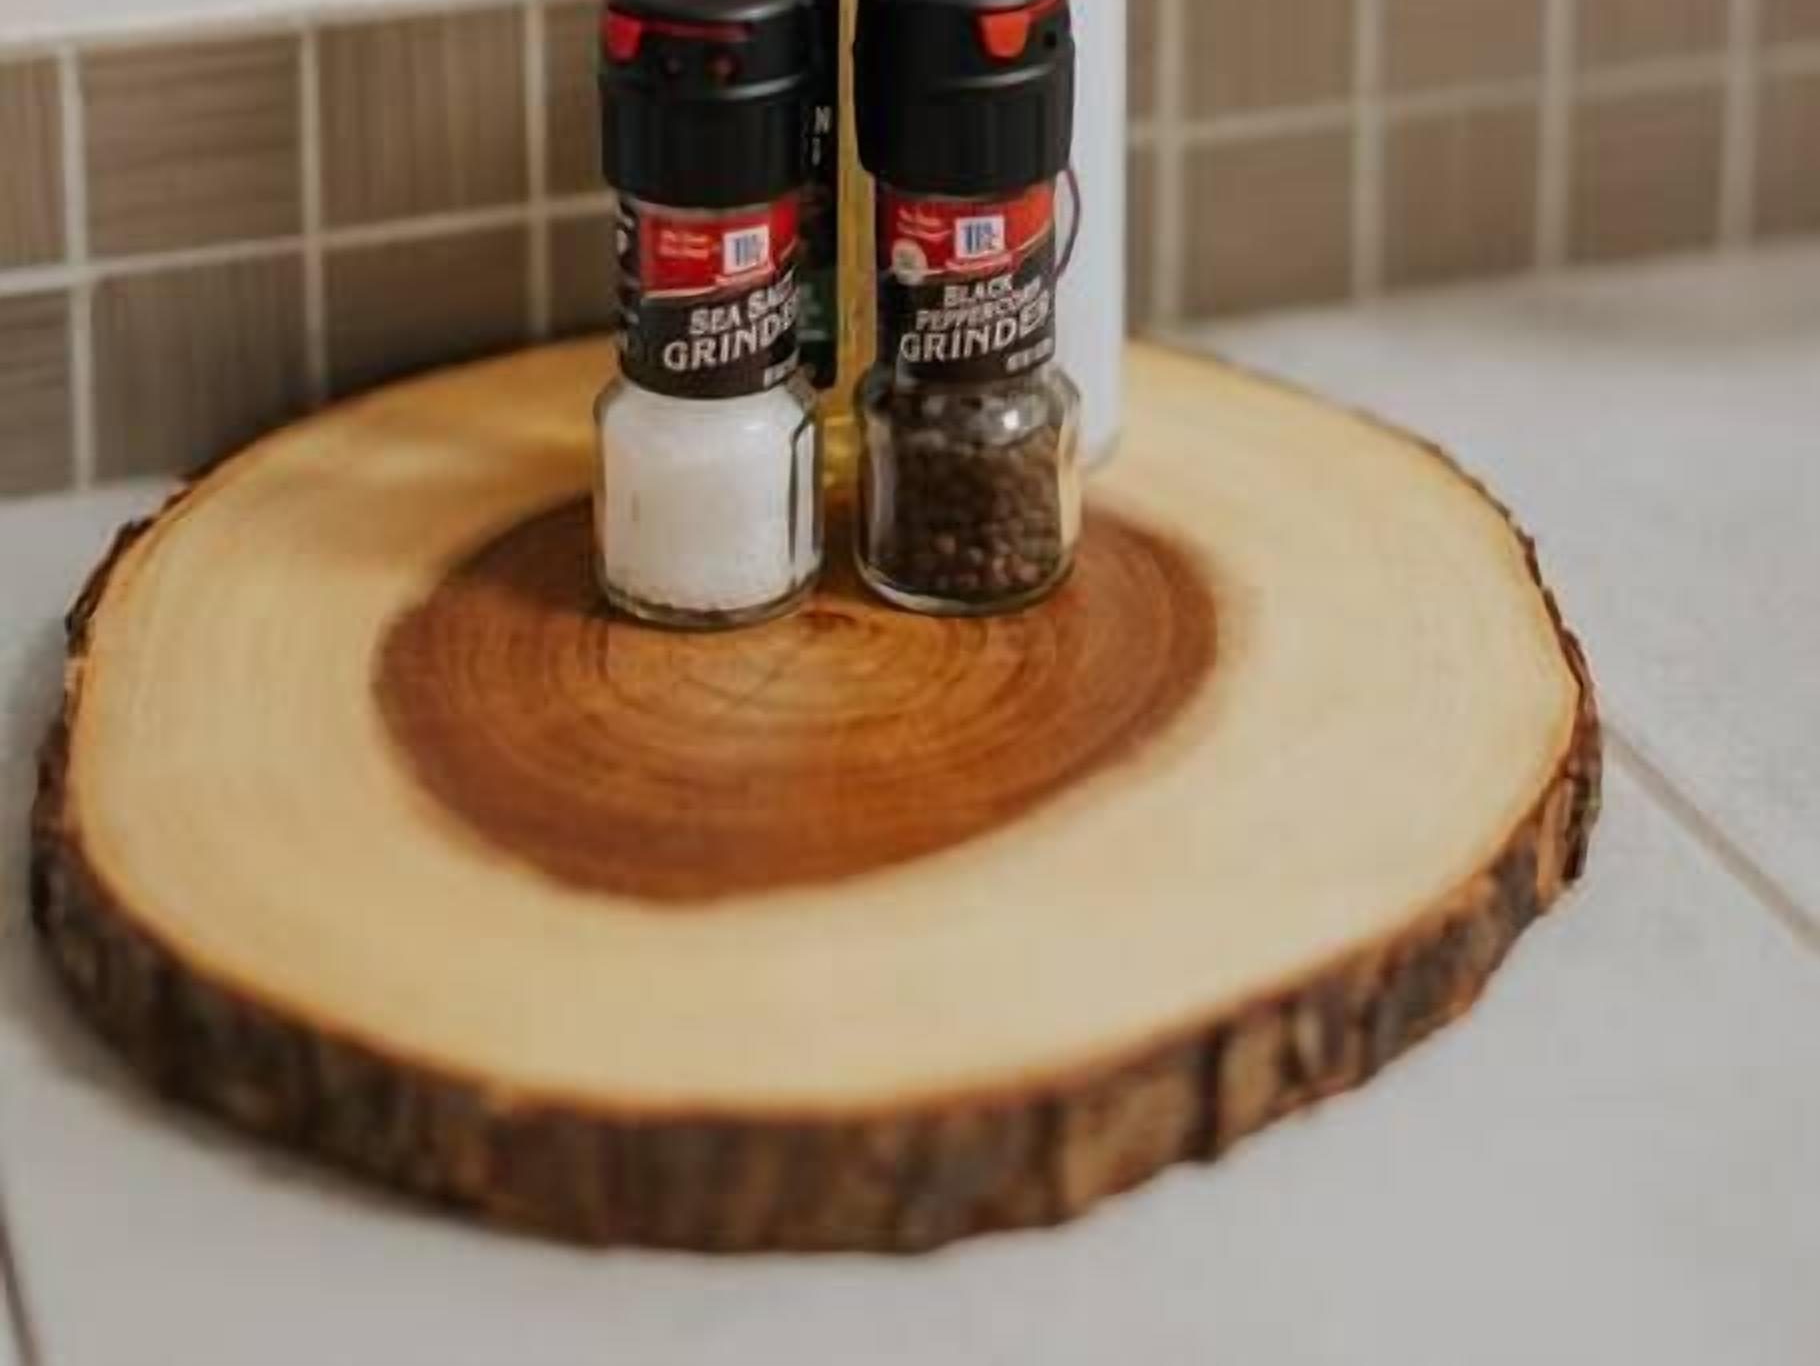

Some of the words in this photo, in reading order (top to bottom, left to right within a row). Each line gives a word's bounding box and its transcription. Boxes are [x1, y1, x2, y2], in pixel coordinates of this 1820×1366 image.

[943, 274, 1015, 308] BLACK
[662, 287, 800, 372] GRINDE
[689, 302, 740, 335] SEA
